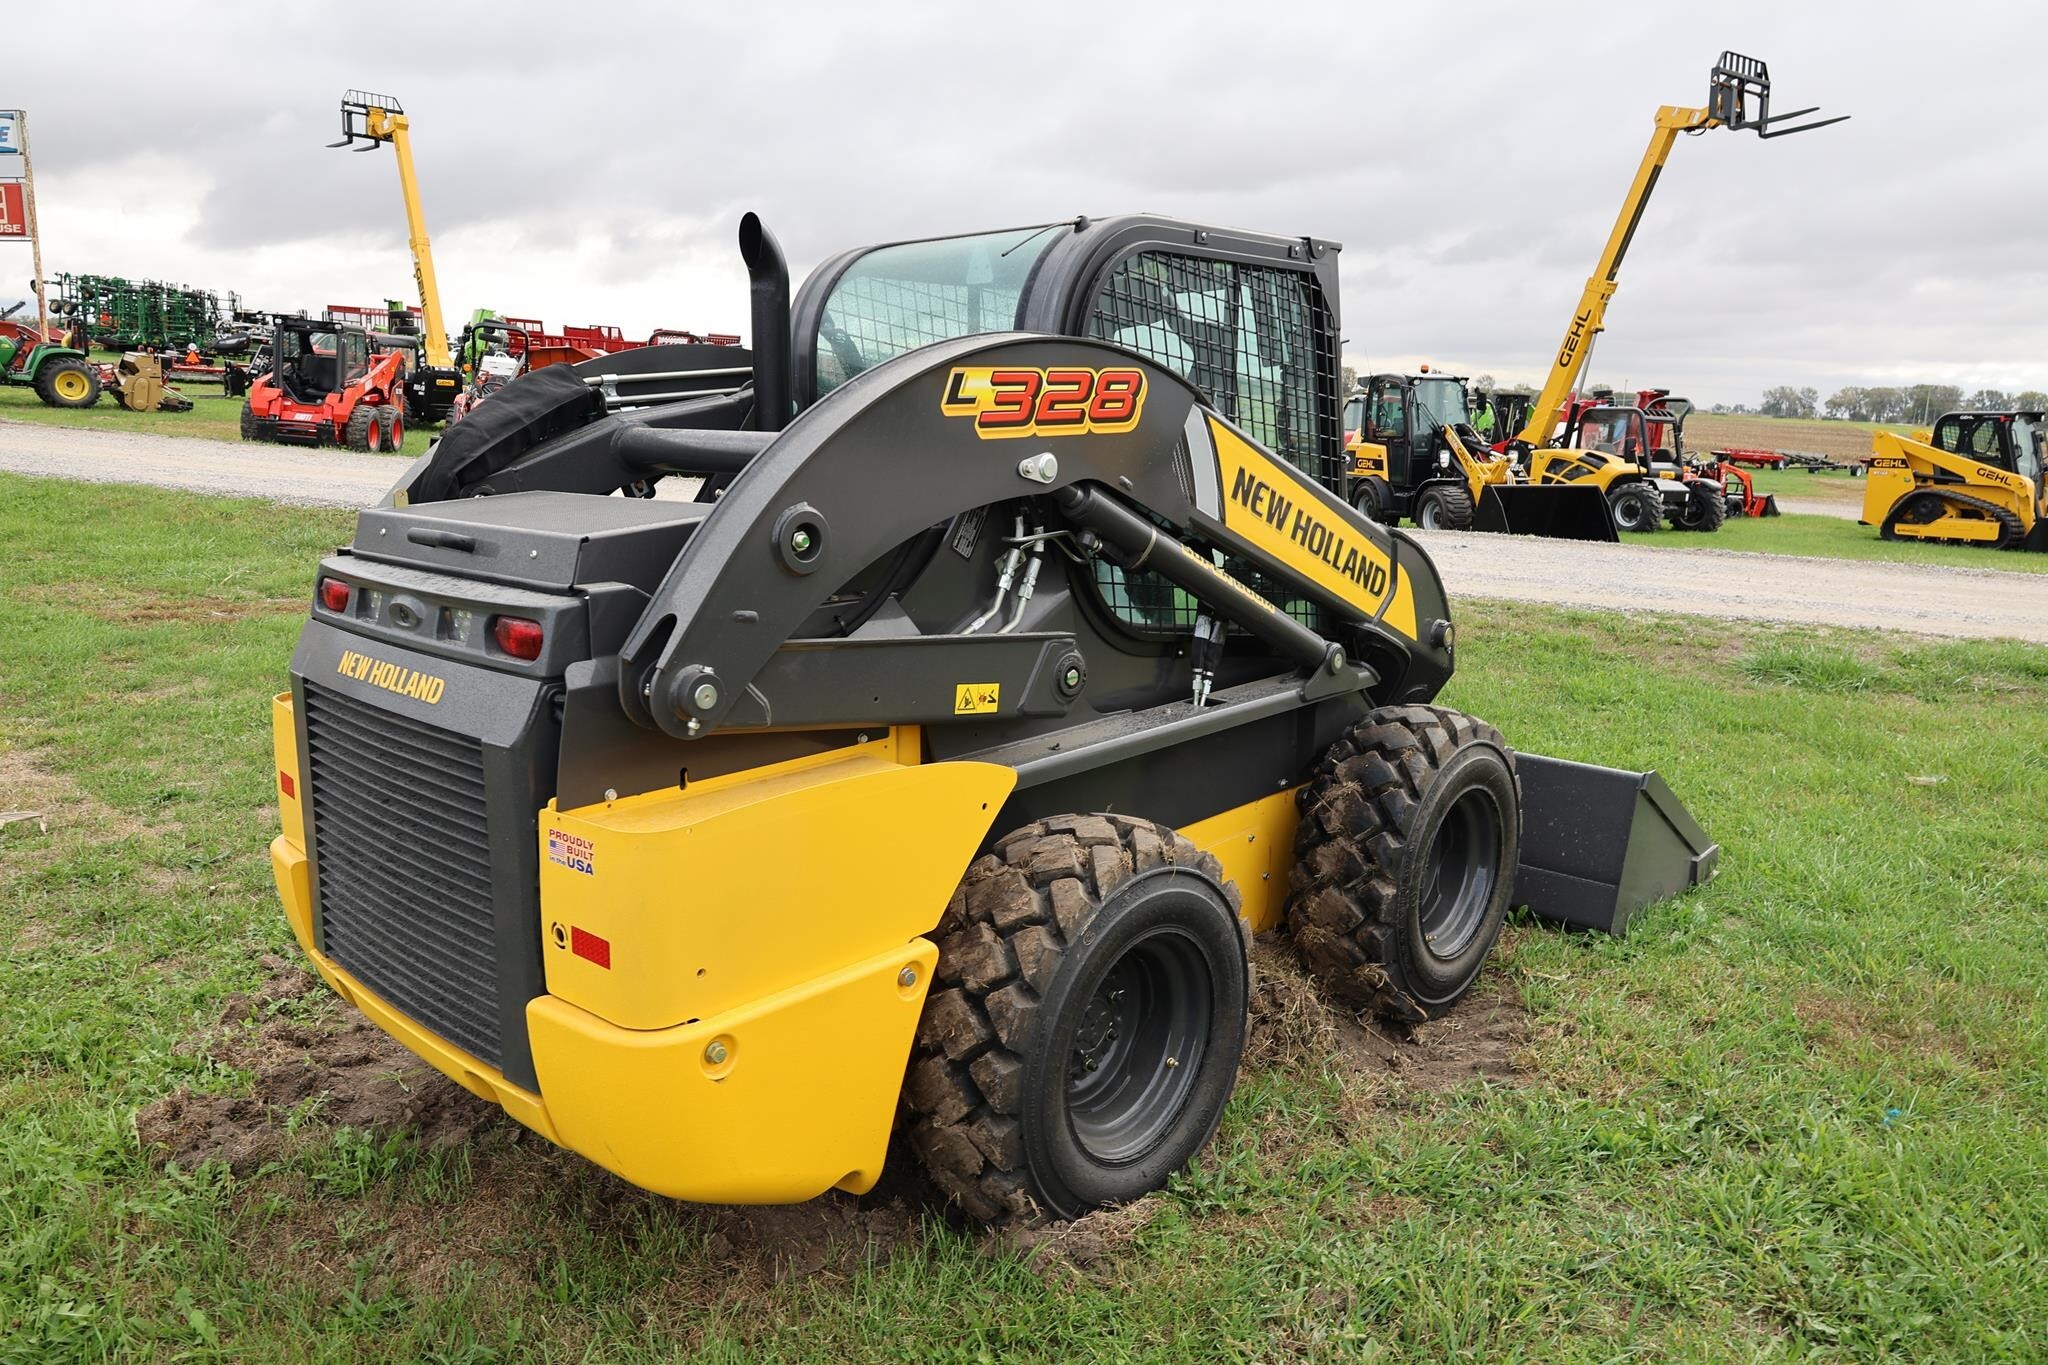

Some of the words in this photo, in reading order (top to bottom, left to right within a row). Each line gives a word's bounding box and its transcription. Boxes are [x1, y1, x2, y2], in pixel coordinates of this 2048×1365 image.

[1559, 309, 1591, 367] GEHL
[1357, 459, 1375, 469] GEHL
[1874, 459, 1906, 468] GEHL
[1976, 467, 2012, 487] GEHL
[1231, 466, 1293, 532] NEW
[1290, 507, 1386, 598] HOLLAND
[337, 650, 374, 681] NEW
[368, 660, 445, 705] HOLLAND
[549, 829, 594, 850] PROUDLY
[566, 845, 594, 861] BUILT
[567, 856, 594, 876] USA
